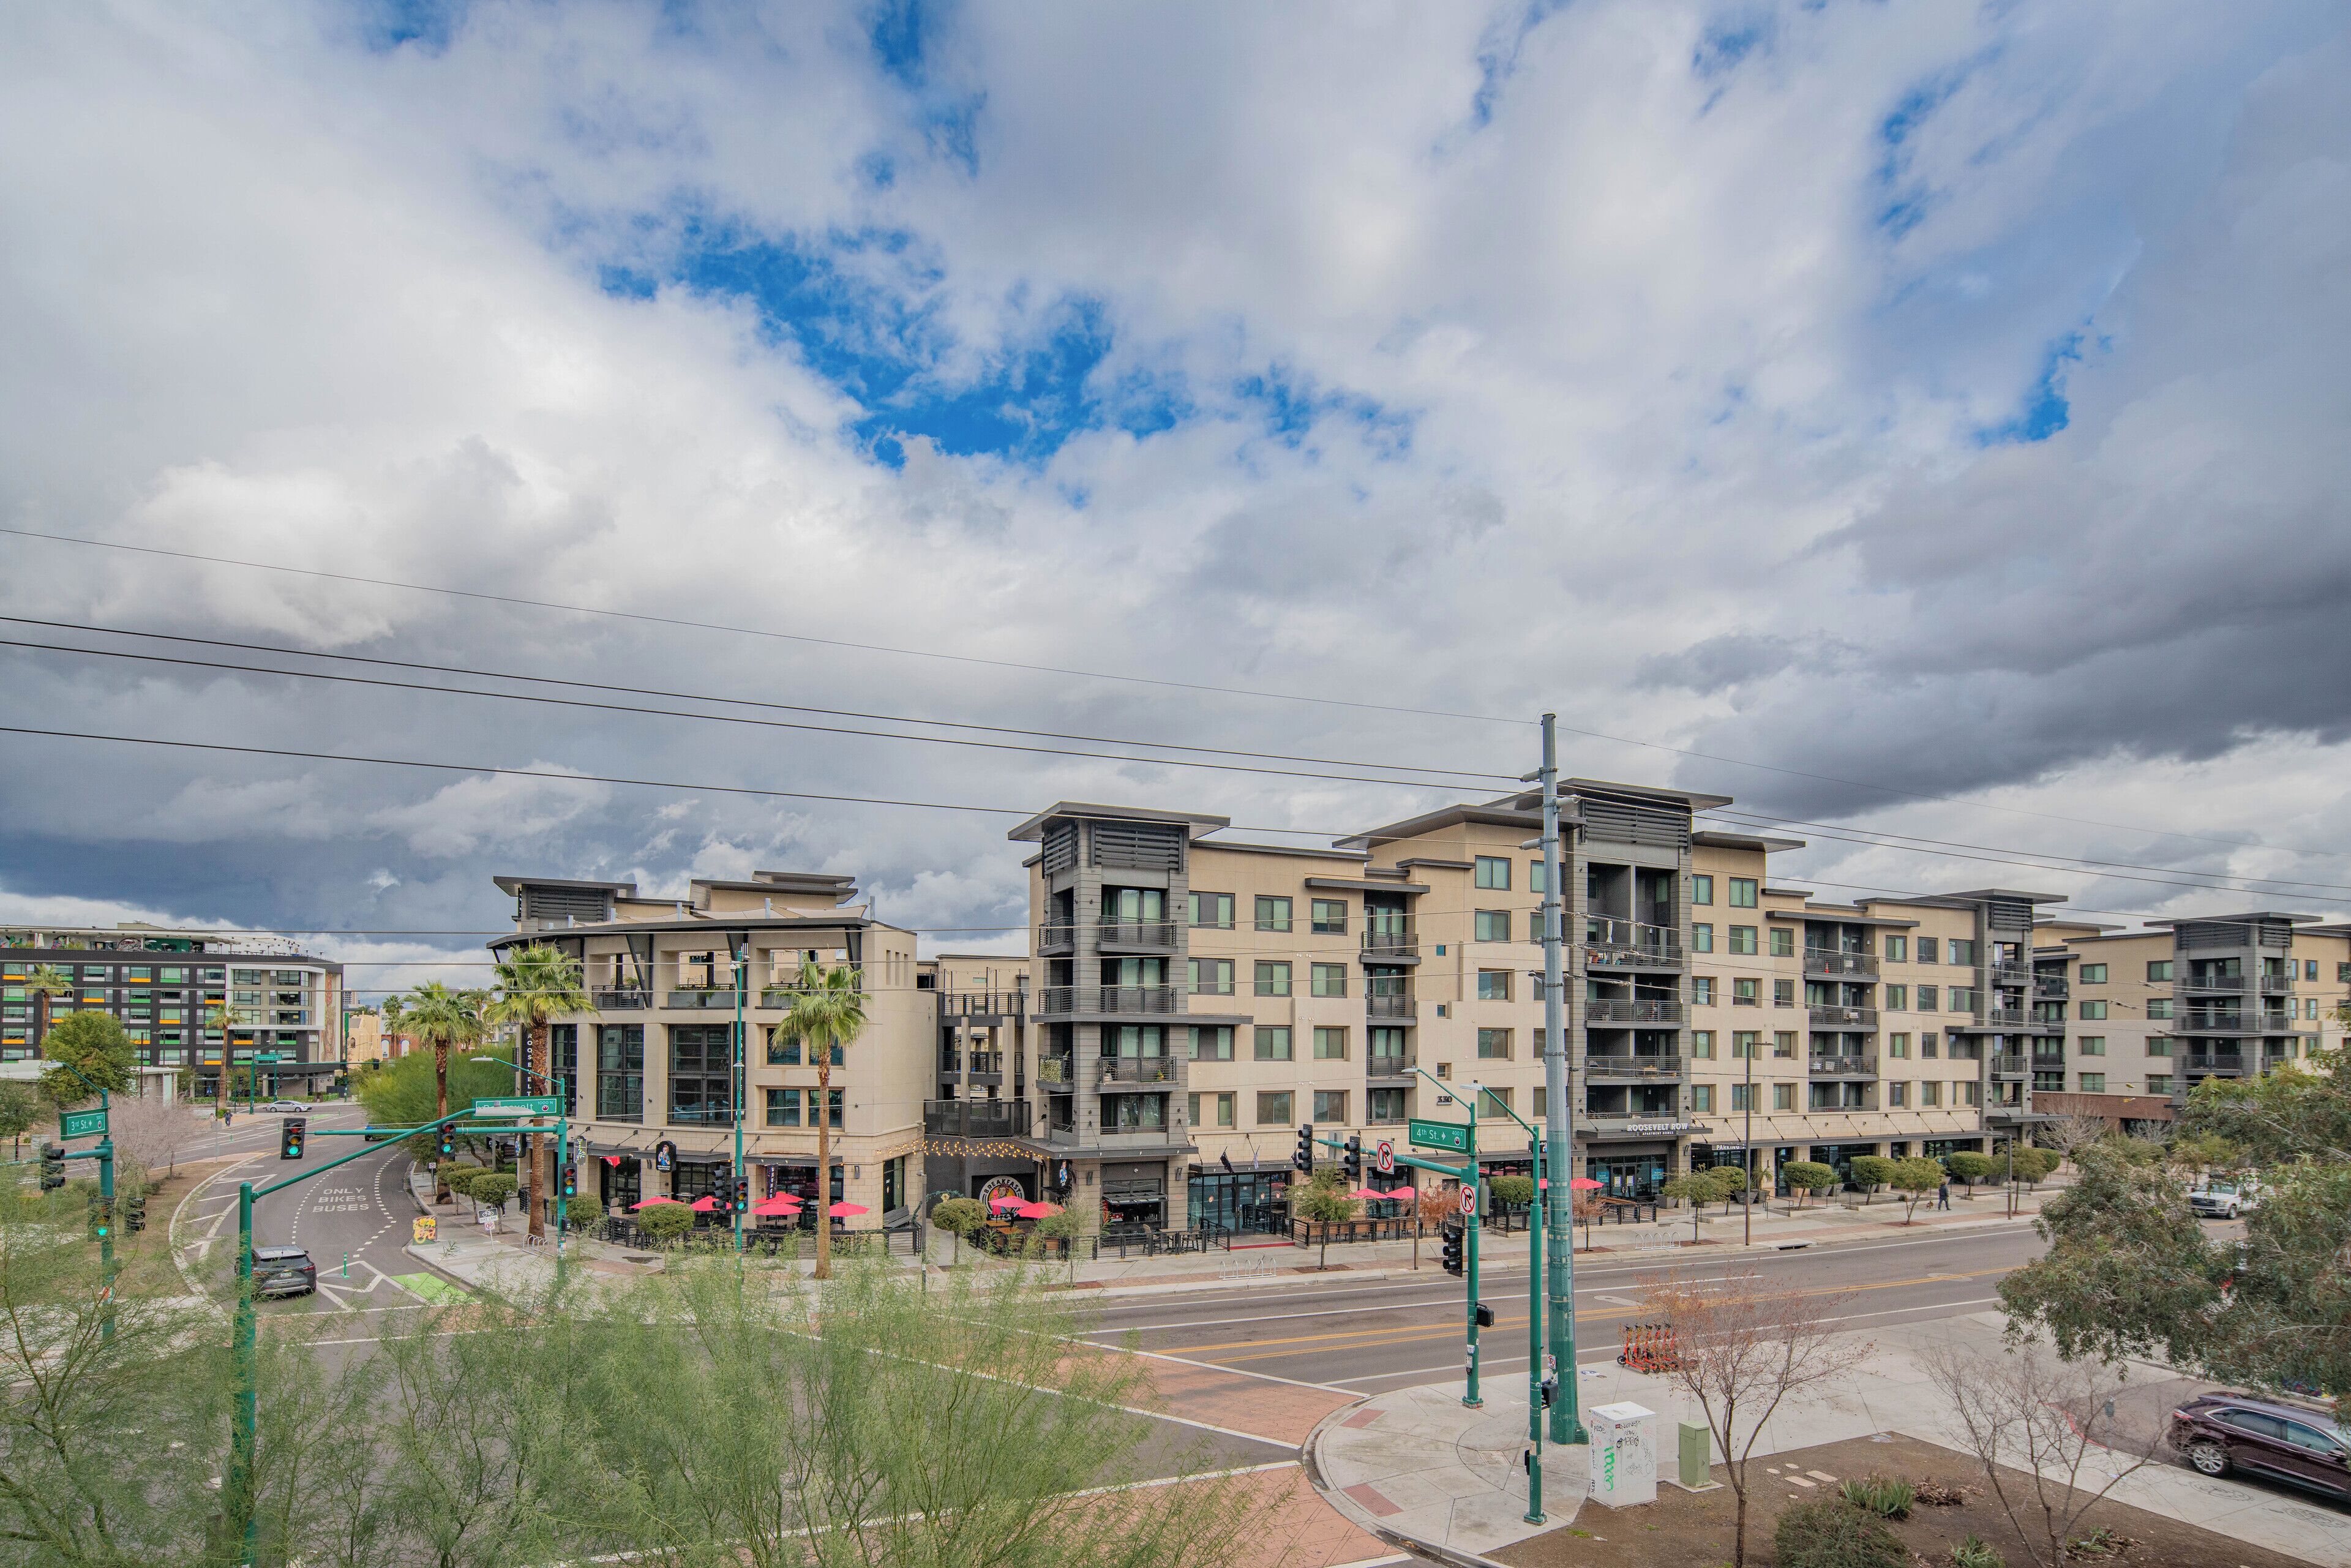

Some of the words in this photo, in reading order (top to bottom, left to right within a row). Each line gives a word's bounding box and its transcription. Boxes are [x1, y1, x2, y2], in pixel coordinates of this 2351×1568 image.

[71, 1120, 80, 1131] 3rd
[1416, 1128, 1427, 1138] 4th
[1429, 1130, 1439, 1140] St.
[983, 1179, 1022, 1195] BREAKFAST
[312, 1204, 369, 1213] BUSES
